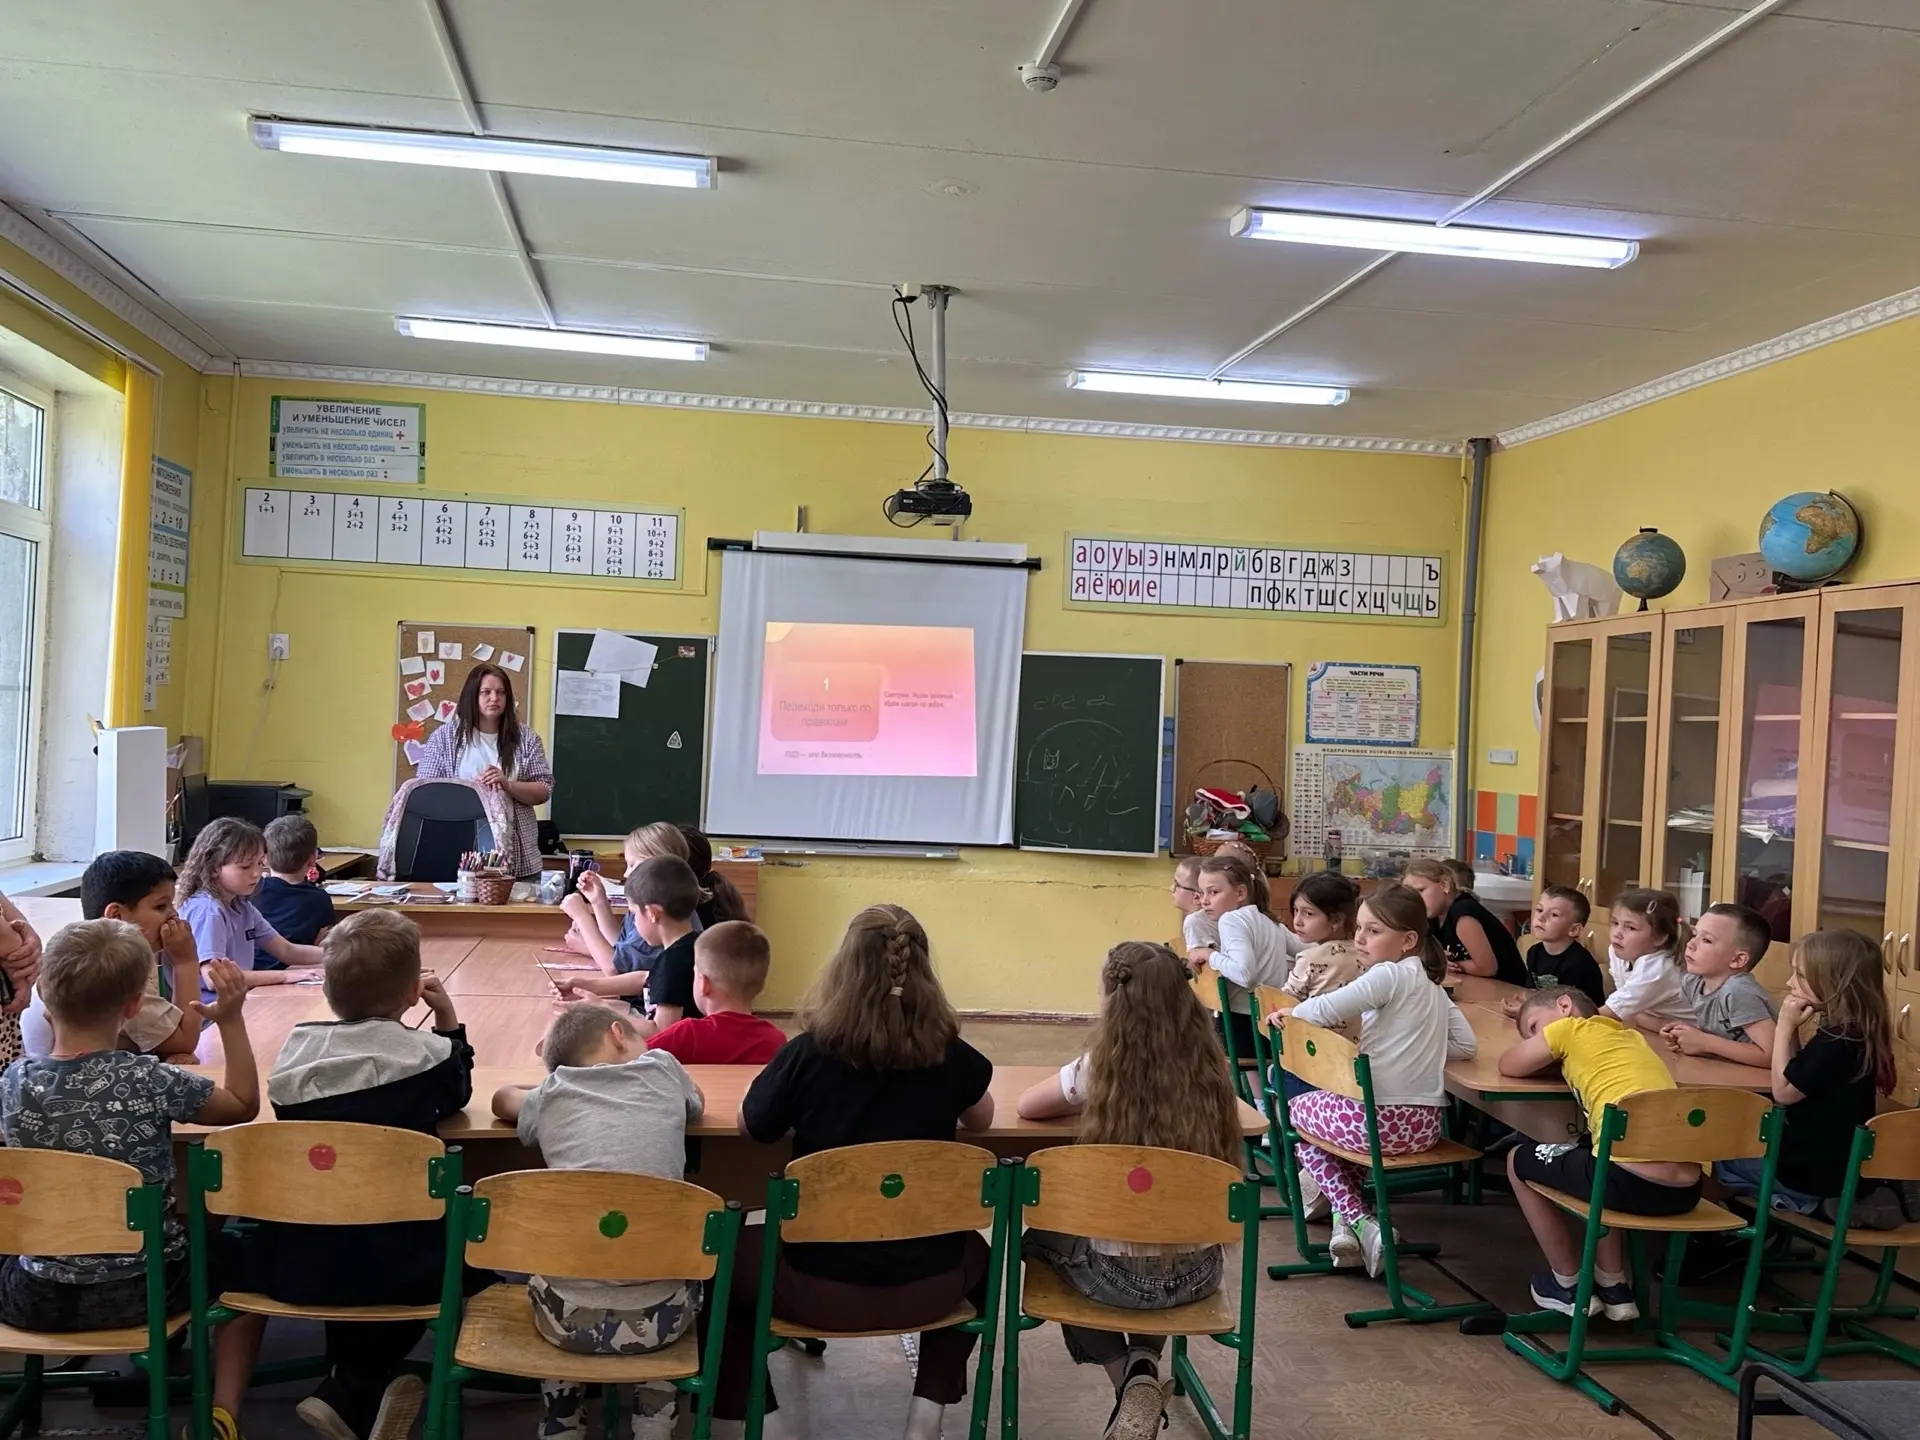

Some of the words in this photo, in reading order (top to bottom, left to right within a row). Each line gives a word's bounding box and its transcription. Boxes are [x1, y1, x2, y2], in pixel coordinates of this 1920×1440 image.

[316, 404, 382, 416] УВЕЛИЧЕНИЕ
[292, 413, 300, 422] И
[301, 413, 371, 426] УМЕНЬШЕНИЕ
[373, 417, 407, 427] ЧИСЕЛ
[282, 426, 320, 435] увеличить
[321, 427, 330, 435] на
[331, 428, 367, 437] несколько
[368, 430, 394, 439] единиц
[282, 441, 321, 450] уменьшить
[333, 442, 368, 451] несколько
[370, 444, 396, 453] единиц
[282, 453, 319, 462] увеличить
[327, 455, 363, 463] несколько
[364, 456, 377, 466] раз
[281, 466, 321, 475] уменьшить
[329, 468, 365, 477] несколько
[366, 470, 379, 479] раз
[258, 506, 275, 514] 1+1
[263, 493, 270, 503] 2
[309, 496, 316, 505] 3
[352, 498, 360, 508] 4
[397, 501, 404, 511] 5
[441, 504, 449, 513] 6
[485, 507, 491, 516] 7
[529, 510, 536, 519] 8
[571, 512, 578, 522] 9
[610, 515, 623, 525] 10
[651, 518, 663, 527] 11
[303, 508, 320, 517] 2+1
[347, 510, 364, 519] 3+1
[391, 514, 408, 522] 4+1
[436, 516, 453, 525] 5+1
[346, 521, 364, 530] 2+2
[479, 519, 495, 527] 6+1
[523, 522, 540, 530] 7+1
[391, 524, 408, 532] 3+2
[435, 526, 453, 535] 4+2
[565, 524, 582, 533] 8+1
[607, 527, 623, 536] 9+1
[479, 529, 495, 538] 5+2
[523, 532, 540, 541] 6+2
[647, 530, 667, 538] 10+1
[435, 536, 452, 545] 3+3
[565, 534, 582, 543] 7+2
[607, 537, 623, 546] 8+2
[478, 539, 495, 548] 4+3
[523, 542, 539, 551] 5+3
[648, 540, 665, 549] 9+2
[565, 544, 582, 553] 6+3
[607, 548, 623, 556] 7+3
[522, 552, 539, 561] 4+4
[647, 550, 664, 558] 8+3
[565, 555, 581, 563] 5+4
[606, 558, 623, 566] 6+4
[648, 560, 664, 568] 7+4
[606, 567, 622, 576] 5+5
[647, 570, 663, 578] 6+5
[823, 677, 829, 692] 1
[779, 701, 825, 713] Переходи
[827, 703, 858, 713] только
[860, 704, 872, 713] по
[802, 717, 848, 729] правилам
